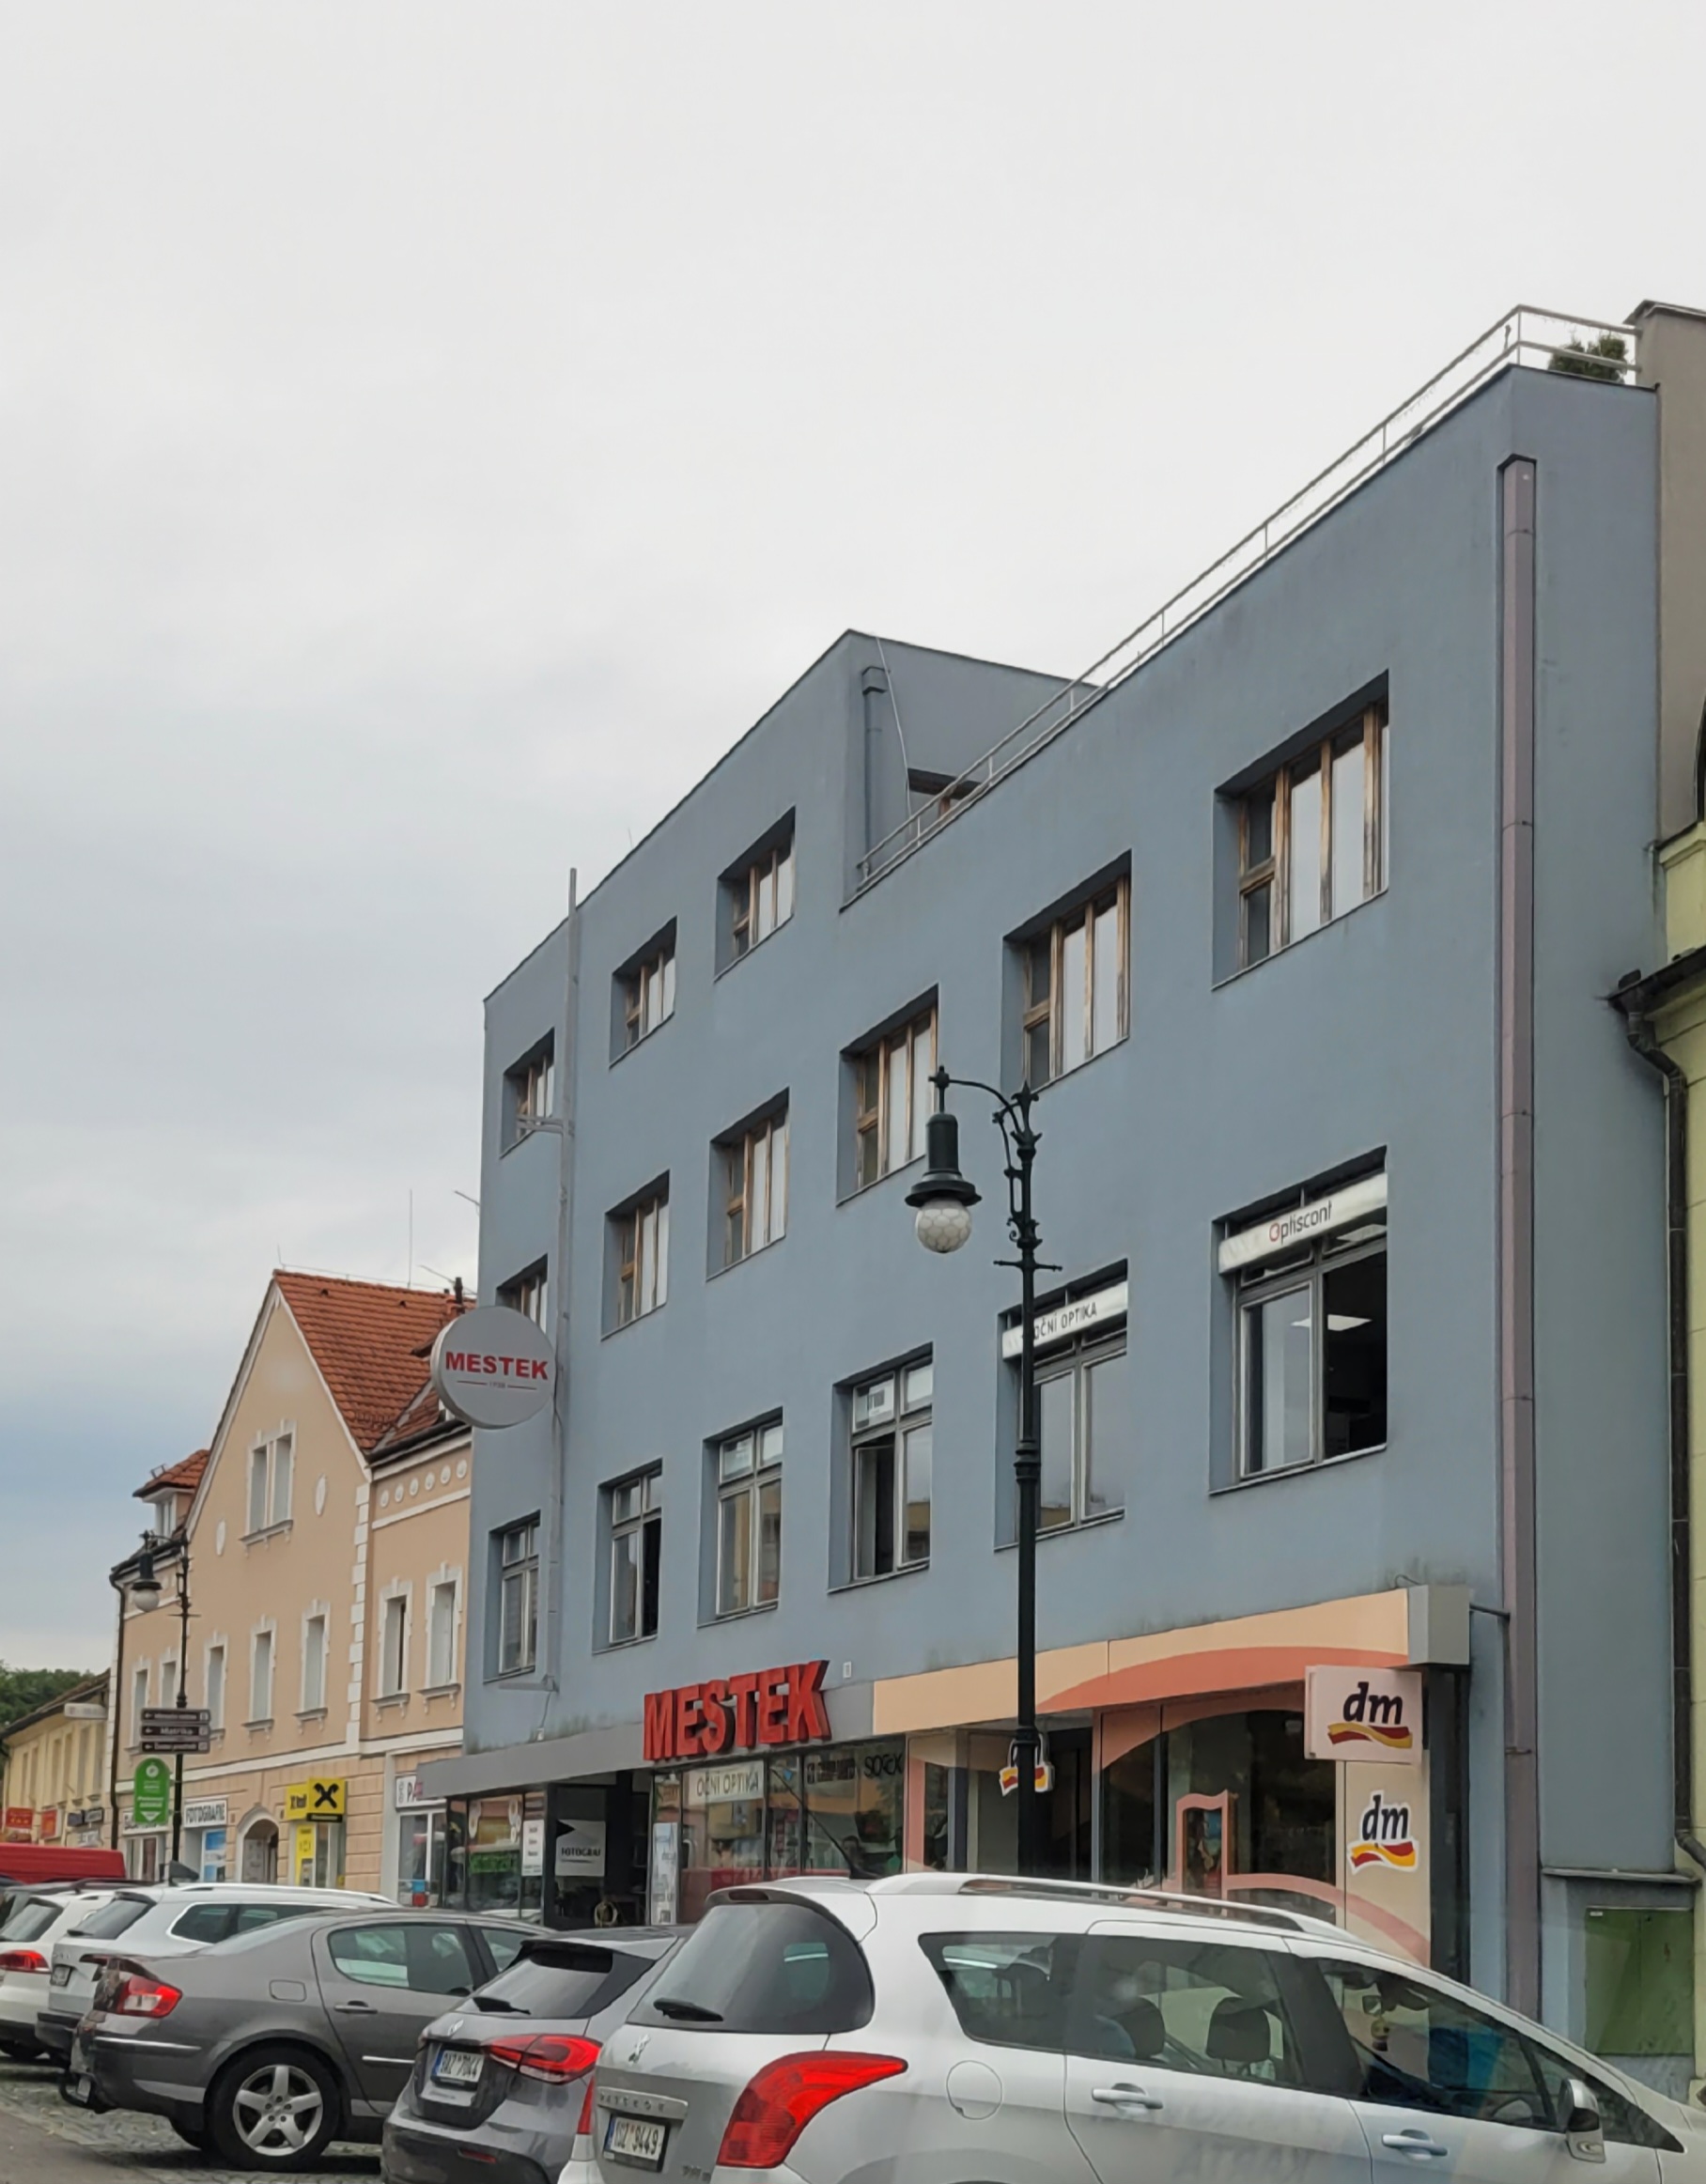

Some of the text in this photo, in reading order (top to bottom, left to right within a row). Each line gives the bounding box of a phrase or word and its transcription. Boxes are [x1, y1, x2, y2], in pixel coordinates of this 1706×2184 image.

[1269, 1200, 1332, 1246] Optiscont
[1034, 1302, 1097, 1340] OČNÍ OPTIKA
[445, 1351, 549, 1381] MESTEK
[644, 1660, 831, 1761] MESTEK
[1342, 1681, 1404, 1726] dm
[722, 1771, 759, 1795] OPTIKA
[1362, 1794, 1409, 1841] dm
